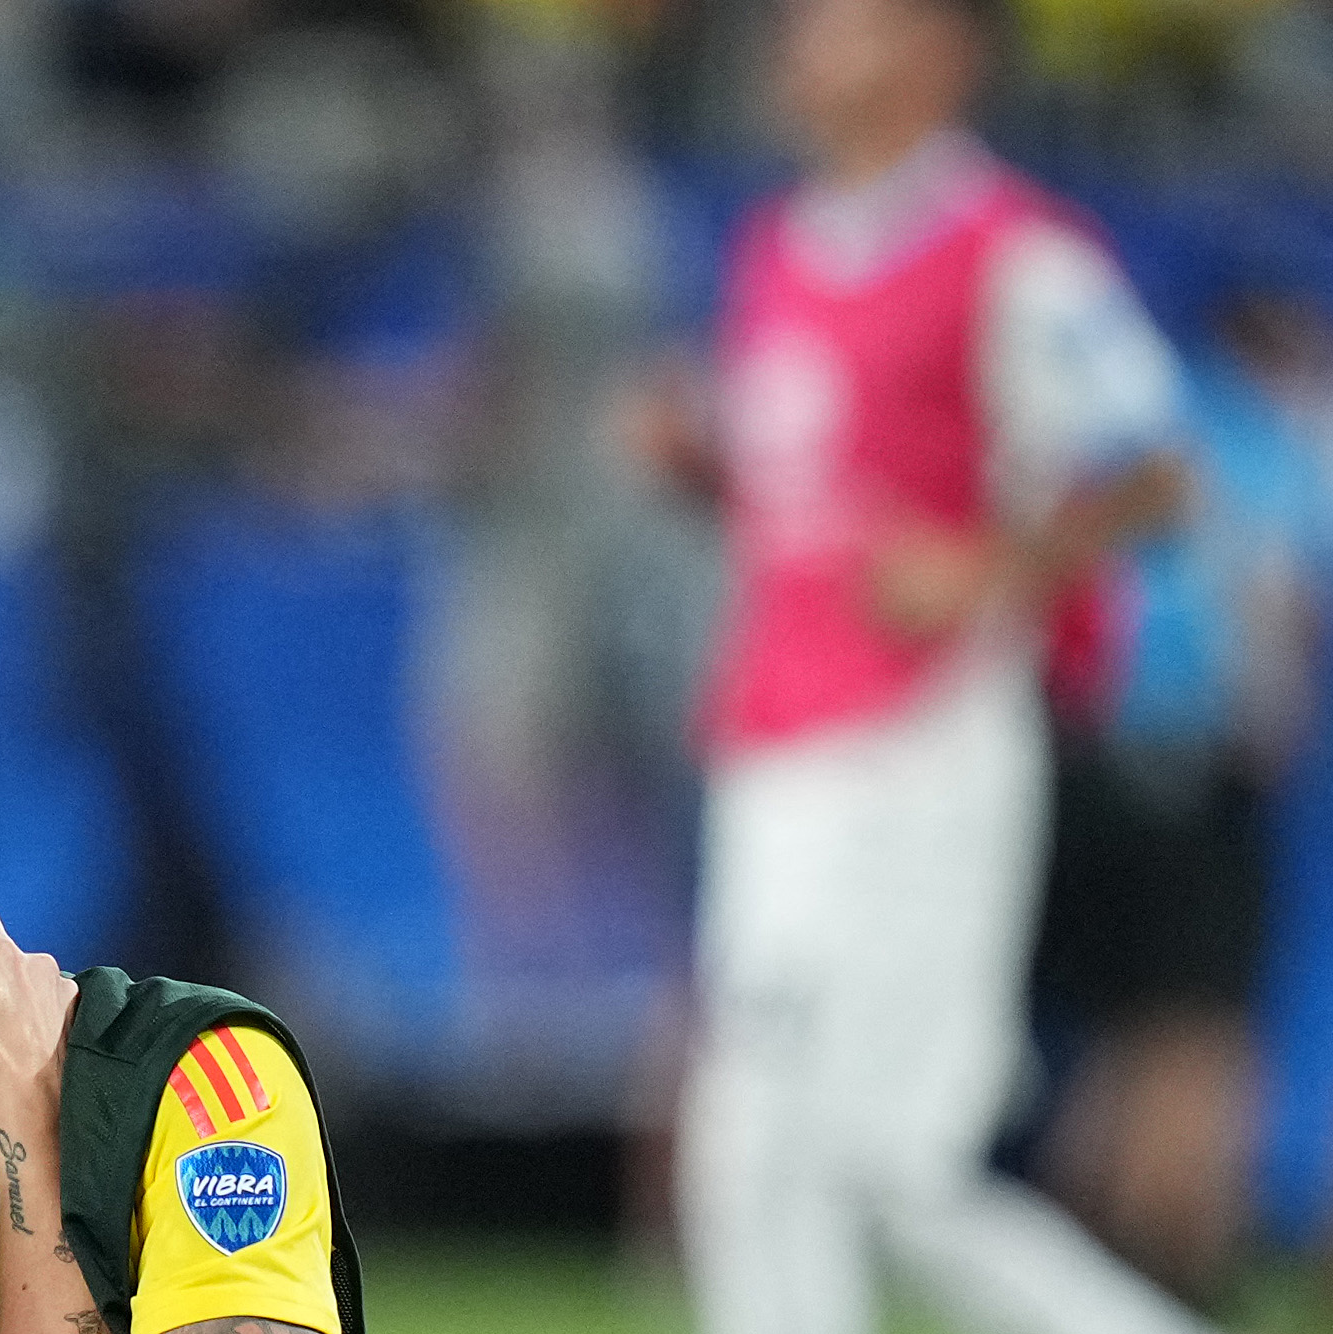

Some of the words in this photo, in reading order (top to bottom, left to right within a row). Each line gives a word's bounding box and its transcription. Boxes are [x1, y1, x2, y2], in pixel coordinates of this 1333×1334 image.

[193, 1174, 274, 1197] VIBRA
[194, 1198, 208, 1208] EL
[210, 1196, 275, 1207] CONTINENTE
